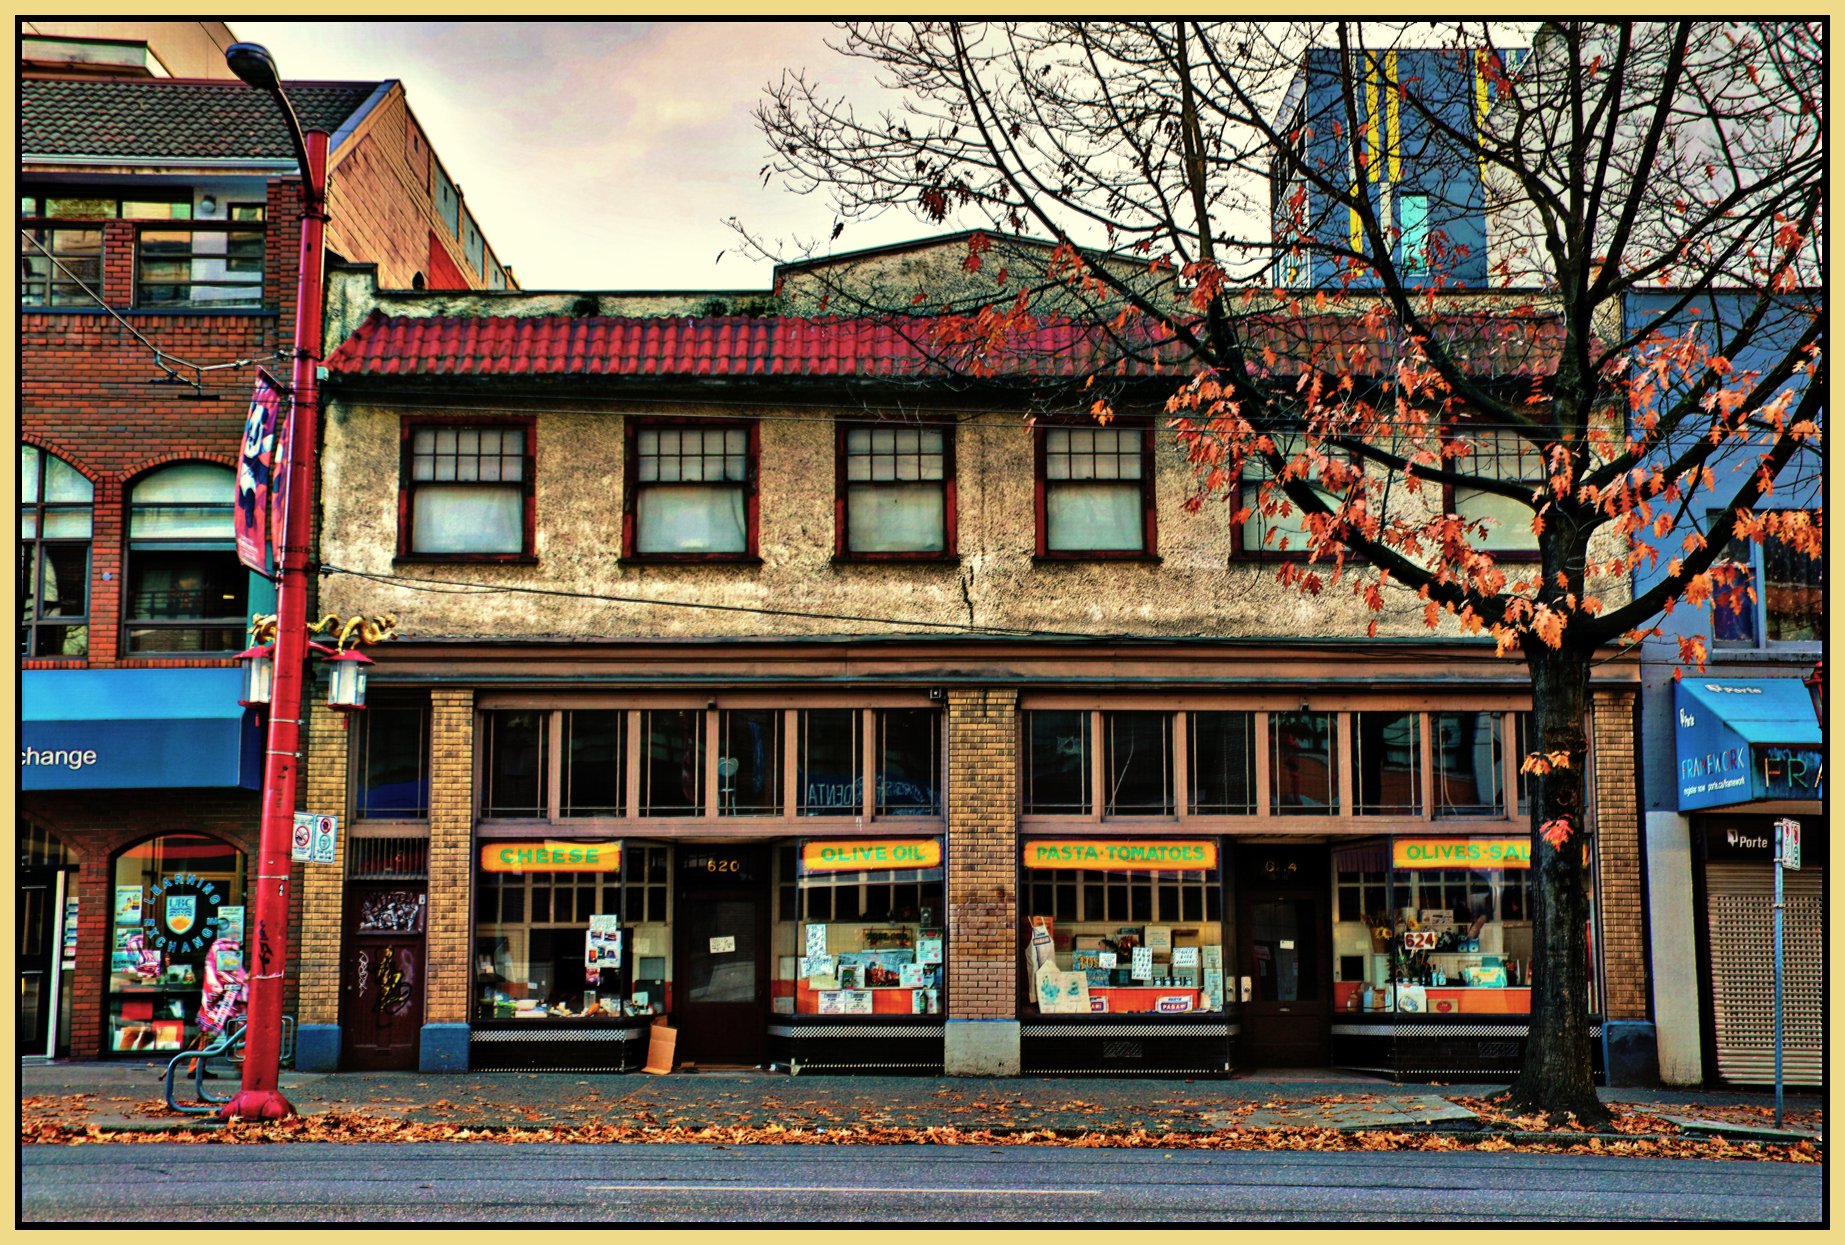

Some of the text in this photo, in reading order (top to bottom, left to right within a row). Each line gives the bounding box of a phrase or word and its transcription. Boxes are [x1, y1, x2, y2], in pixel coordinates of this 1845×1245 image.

[1681, 747, 1745, 780] FRAMEWORK
[1739, 836, 1768, 848] Porte
[500, 848, 600, 864] CHEESE
[821, 845, 926, 861] OLIVE OIL
[707, 859, 740, 872] 620
[143, 873, 222, 905] LEARNING
[169, 898, 193, 908] UBC
[143, 918, 219, 954] EXCHANGE
[1405, 933, 1434, 948] 624
